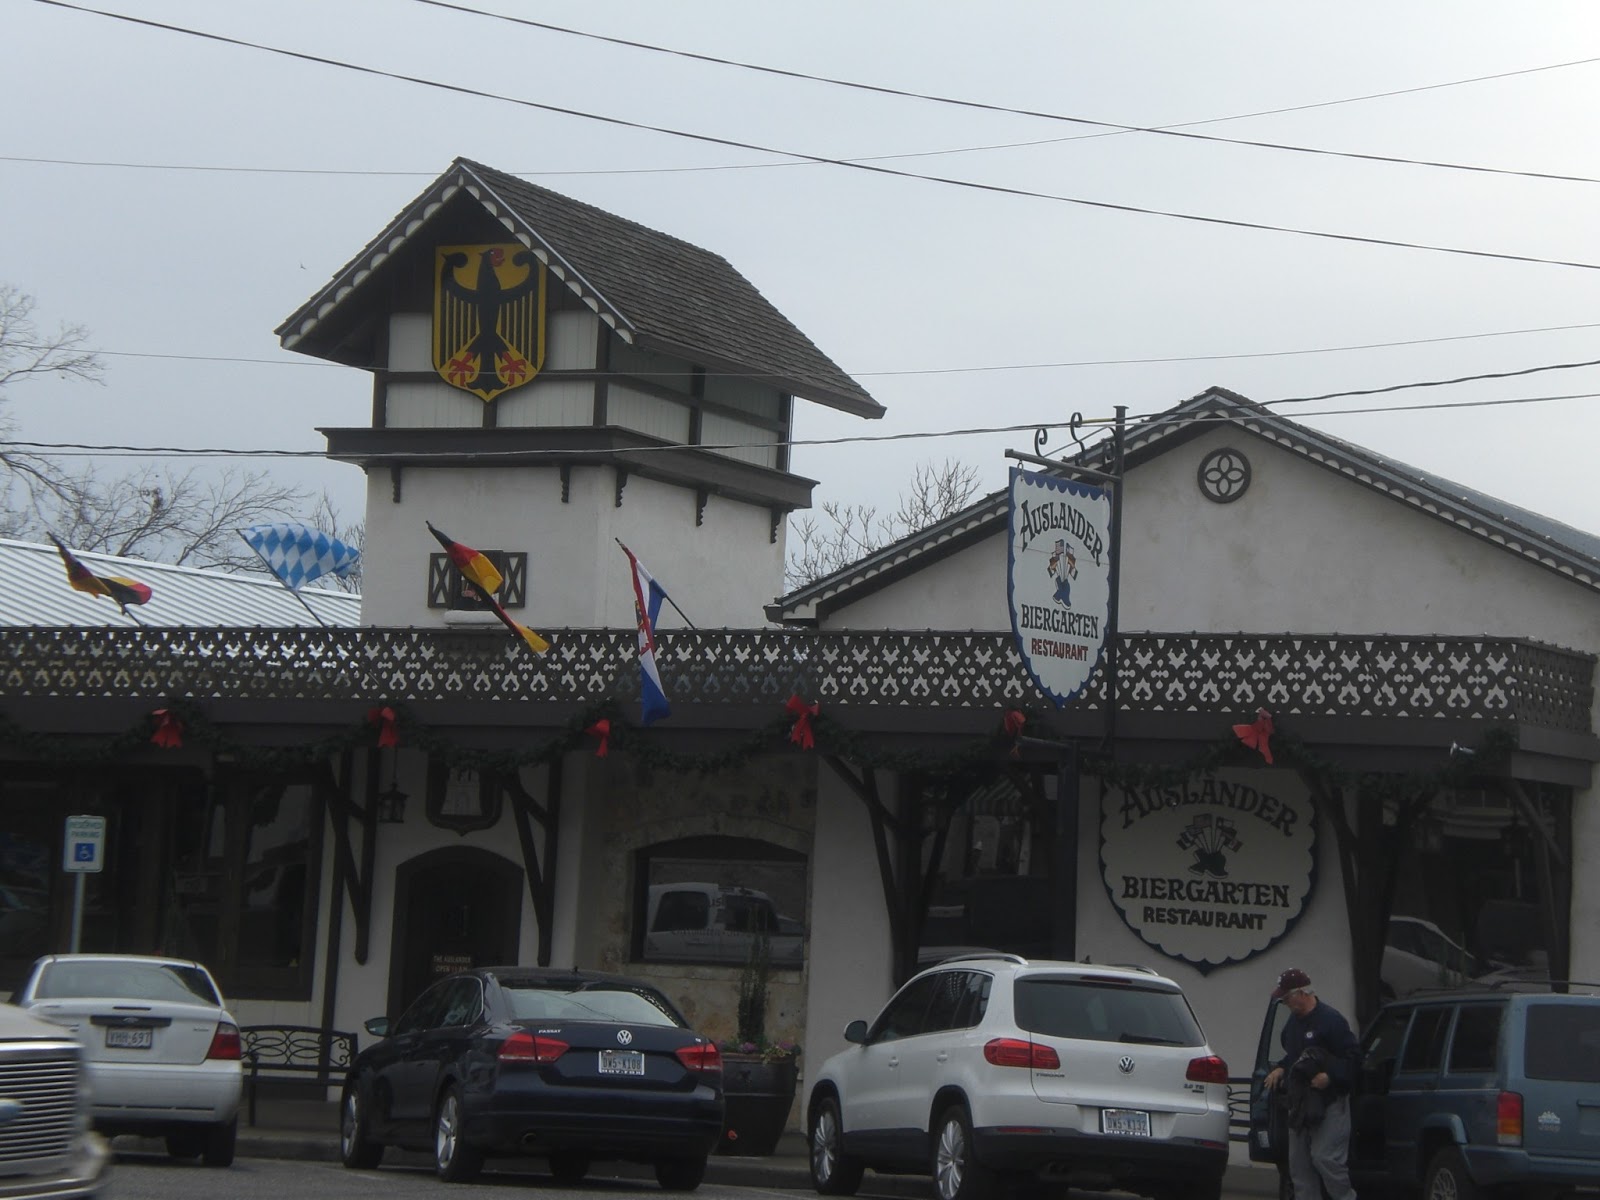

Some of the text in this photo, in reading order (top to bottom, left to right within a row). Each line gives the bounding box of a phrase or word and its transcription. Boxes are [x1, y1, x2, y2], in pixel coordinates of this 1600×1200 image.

[1020, 500, 1104, 567] AUSLANDER
[1021, 604, 1099, 639] BIERGARTEN
[1031, 638, 1088, 662] RESTAURANT
[1119, 779, 1298, 837] AUSLANDER
[1121, 875, 1290, 908] BIERGARTEN
[1143, 906, 1267, 931] RESTAURANT
